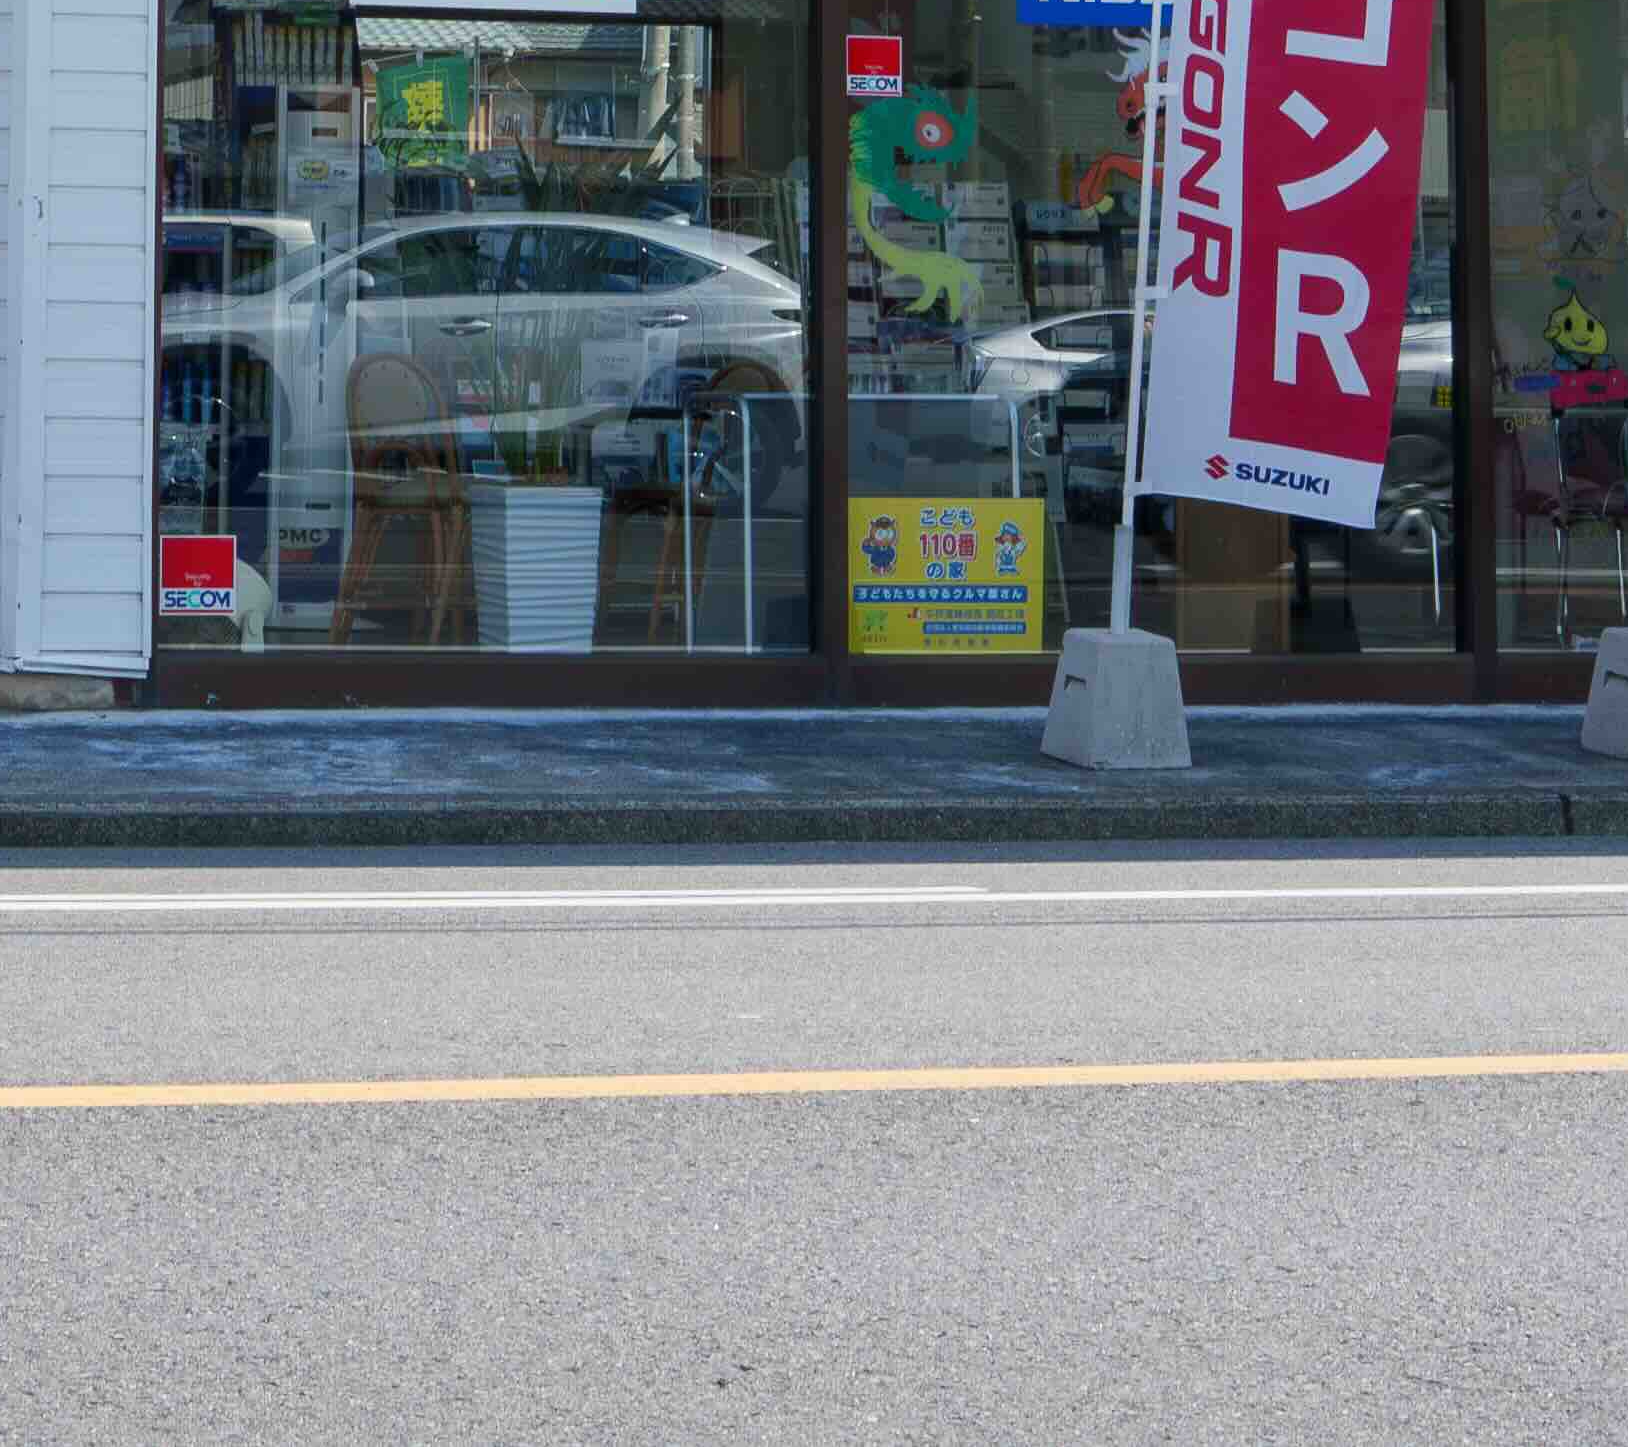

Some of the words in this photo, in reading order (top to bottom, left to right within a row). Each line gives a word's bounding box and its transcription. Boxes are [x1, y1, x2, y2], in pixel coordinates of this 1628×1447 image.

[850, 77, 898, 90] SECOM
[1235, 461, 1330, 496] SUZUKI
[920, 508, 975, 528] こども
[920, 533, 976, 558] 110番
[164, 591, 230, 608] SECOM
